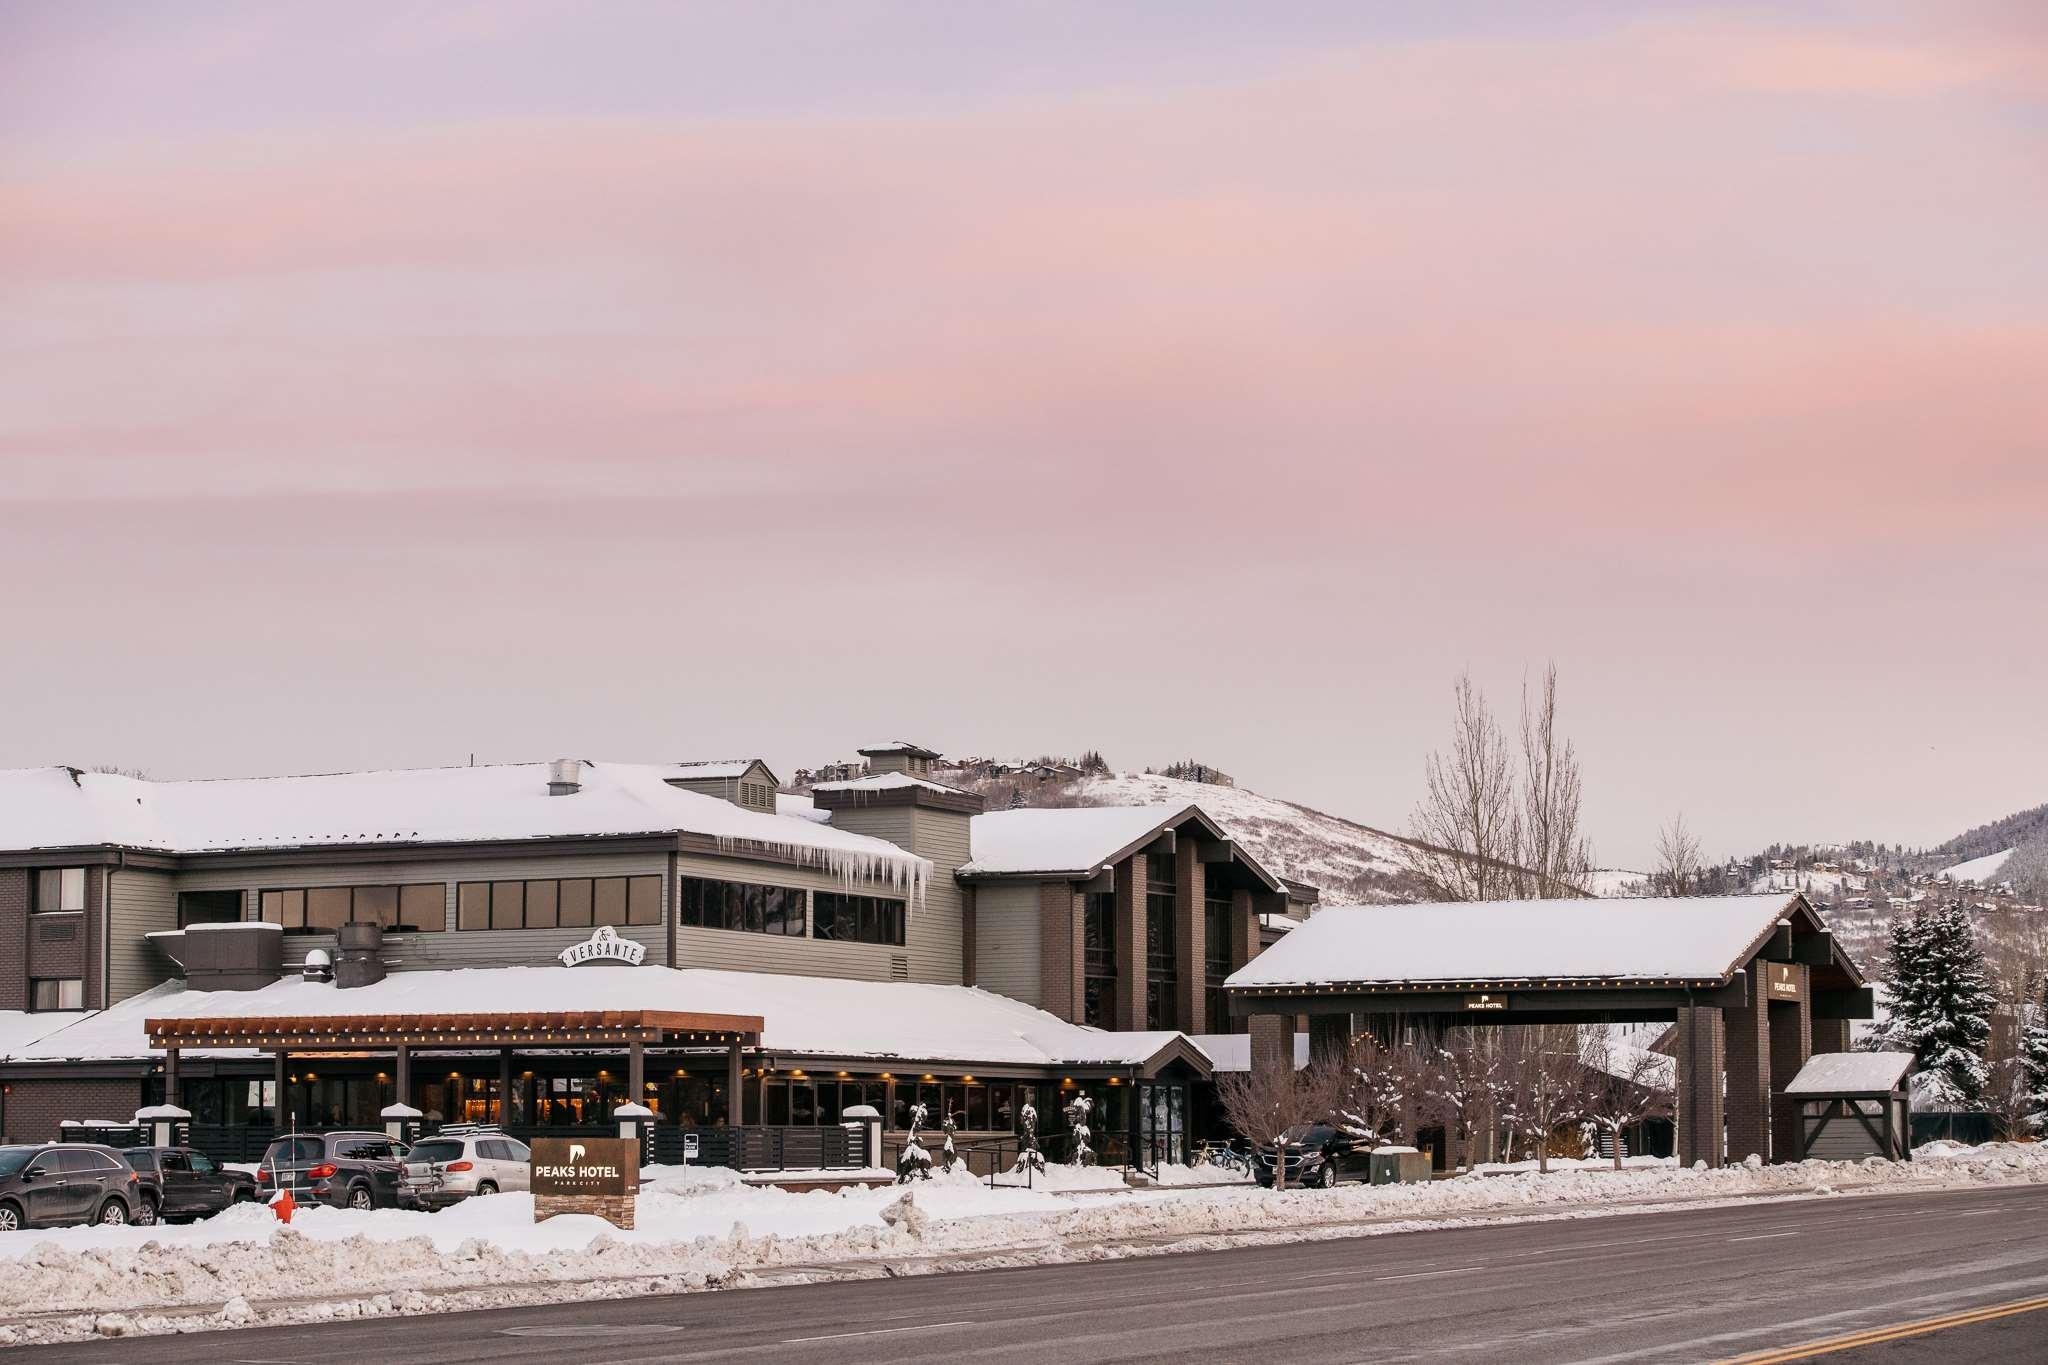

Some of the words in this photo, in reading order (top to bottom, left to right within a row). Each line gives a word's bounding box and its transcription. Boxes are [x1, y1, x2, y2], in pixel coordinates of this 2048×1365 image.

[569, 941, 637, 962] VERSANTE
[535, 1166, 575, 1177] PEAKS
[579, 1166, 619, 1177] HOTEL
